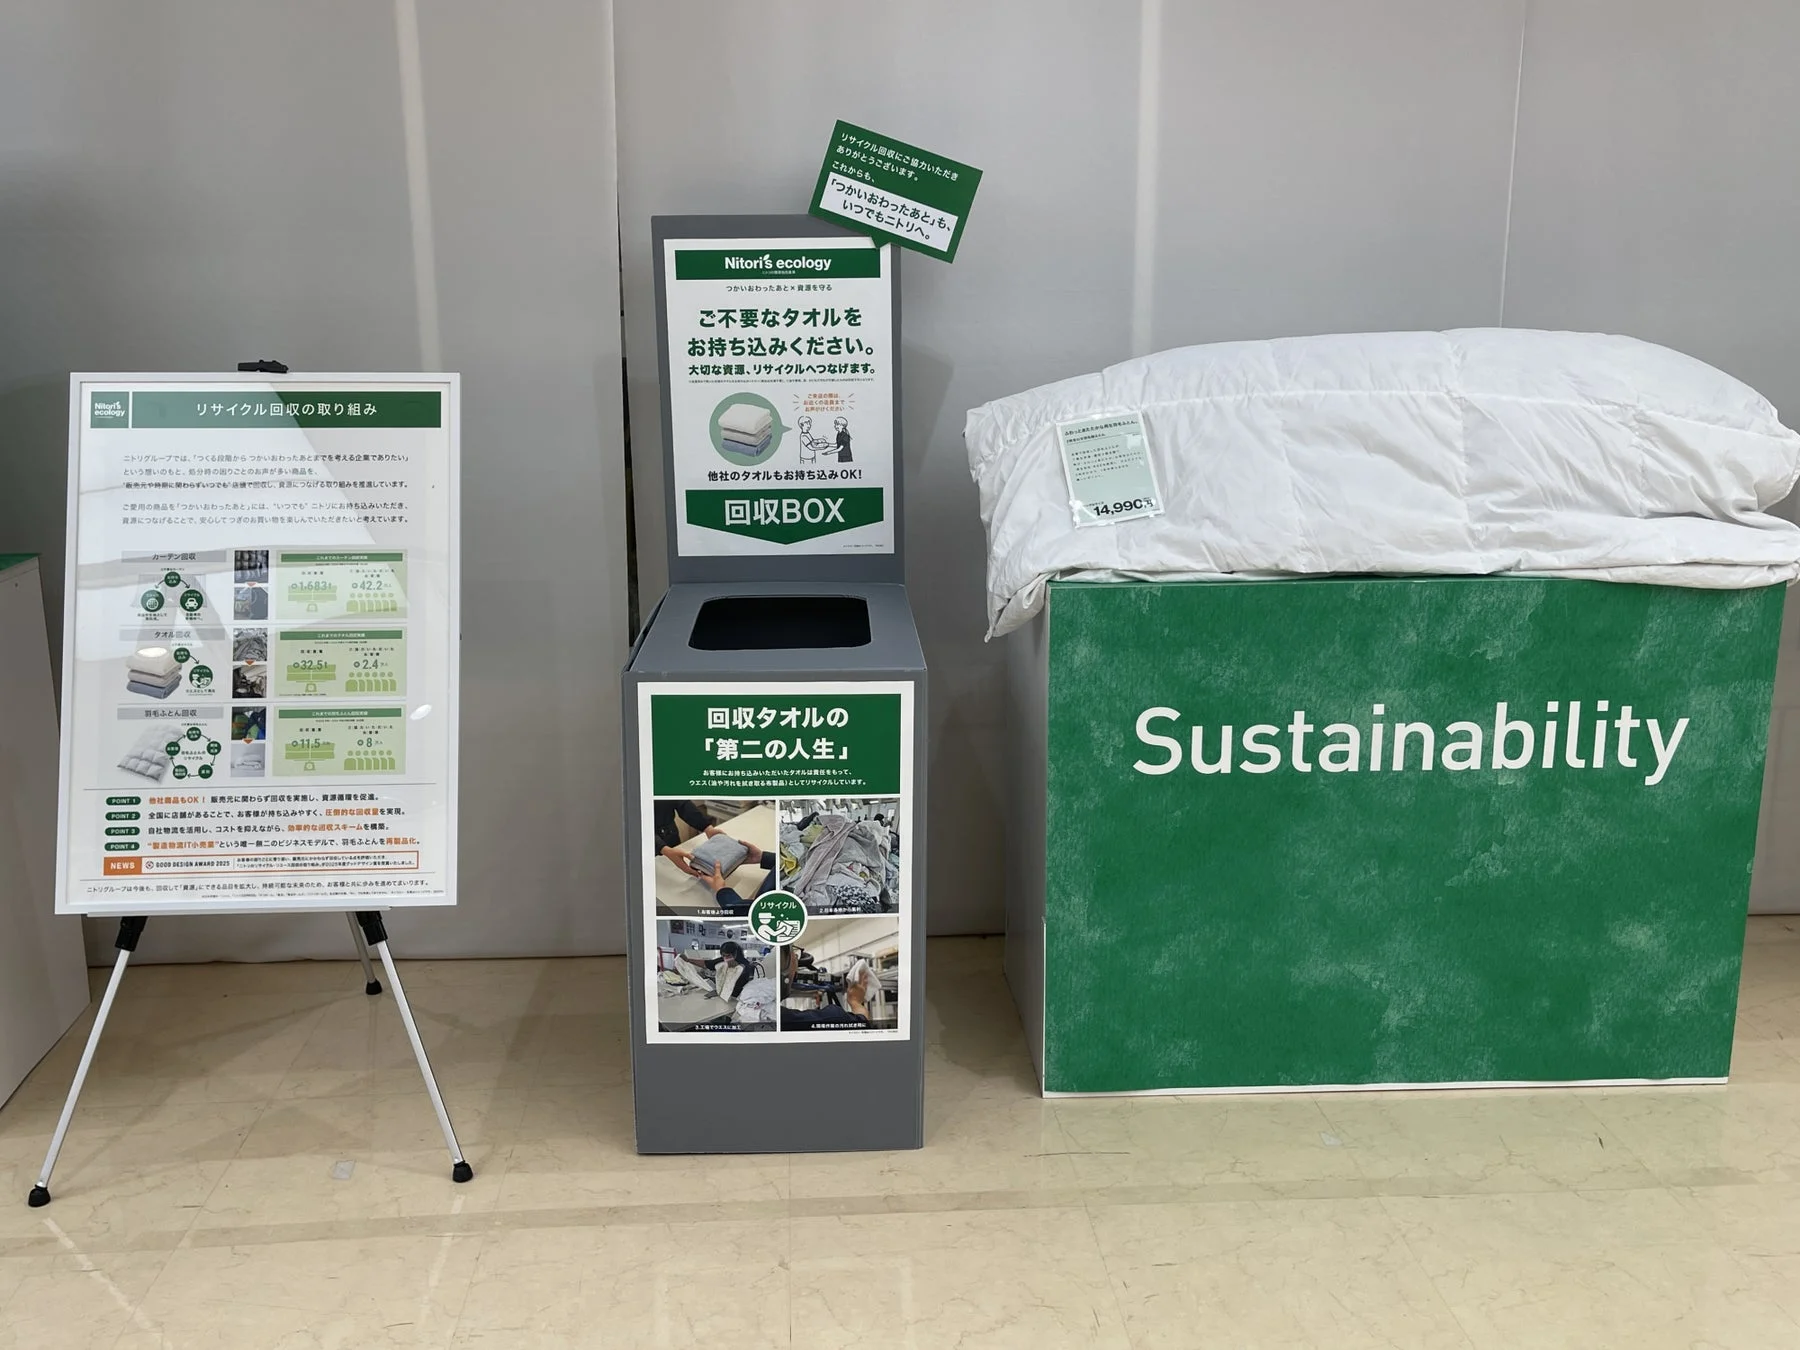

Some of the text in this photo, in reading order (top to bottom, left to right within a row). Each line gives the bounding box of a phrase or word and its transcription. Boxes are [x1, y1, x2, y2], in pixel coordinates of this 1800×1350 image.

[836, 145, 918, 181] ありがとうございます。
[841, 132, 959, 181] リサイクル回収にご協力いただき
[831, 160, 875, 183] これからも、
[830, 178, 951, 232] 「つかいおわったあと」も、
[842, 199, 930, 240] いつでもニトリへ。
[724, 253, 832, 271] Nitori's ecology
[699, 307, 862, 329] ご不要なタオルを
[687, 336, 874, 357] お持ち込みください。
[688, 363, 876, 376] 大切な資源、リサイクルへつなげます。
[94, 408, 126, 417] ecology
[196, 403, 378, 417] リサイクル回収の取り組み
[724, 497, 846, 526] 回収BOX
[152, 552, 197, 561] カーテン回収
[359, 580, 383, 591] 42.2
[154, 630, 192, 639] タオル回収
[362, 658, 379, 670] 2.4
[144, 709, 198, 718] 羽毛ふとん回収
[707, 706, 849, 729] 回収タオルの
[299, 738, 321, 749] 11.5
[366, 737, 373, 748] 8
[704, 737, 848, 761] 「第二の人生」
[1131, 699, 1691, 787] Sustainability
[110, 861, 136, 870] NEWS
[759, 900, 798, 911] リサイクル
